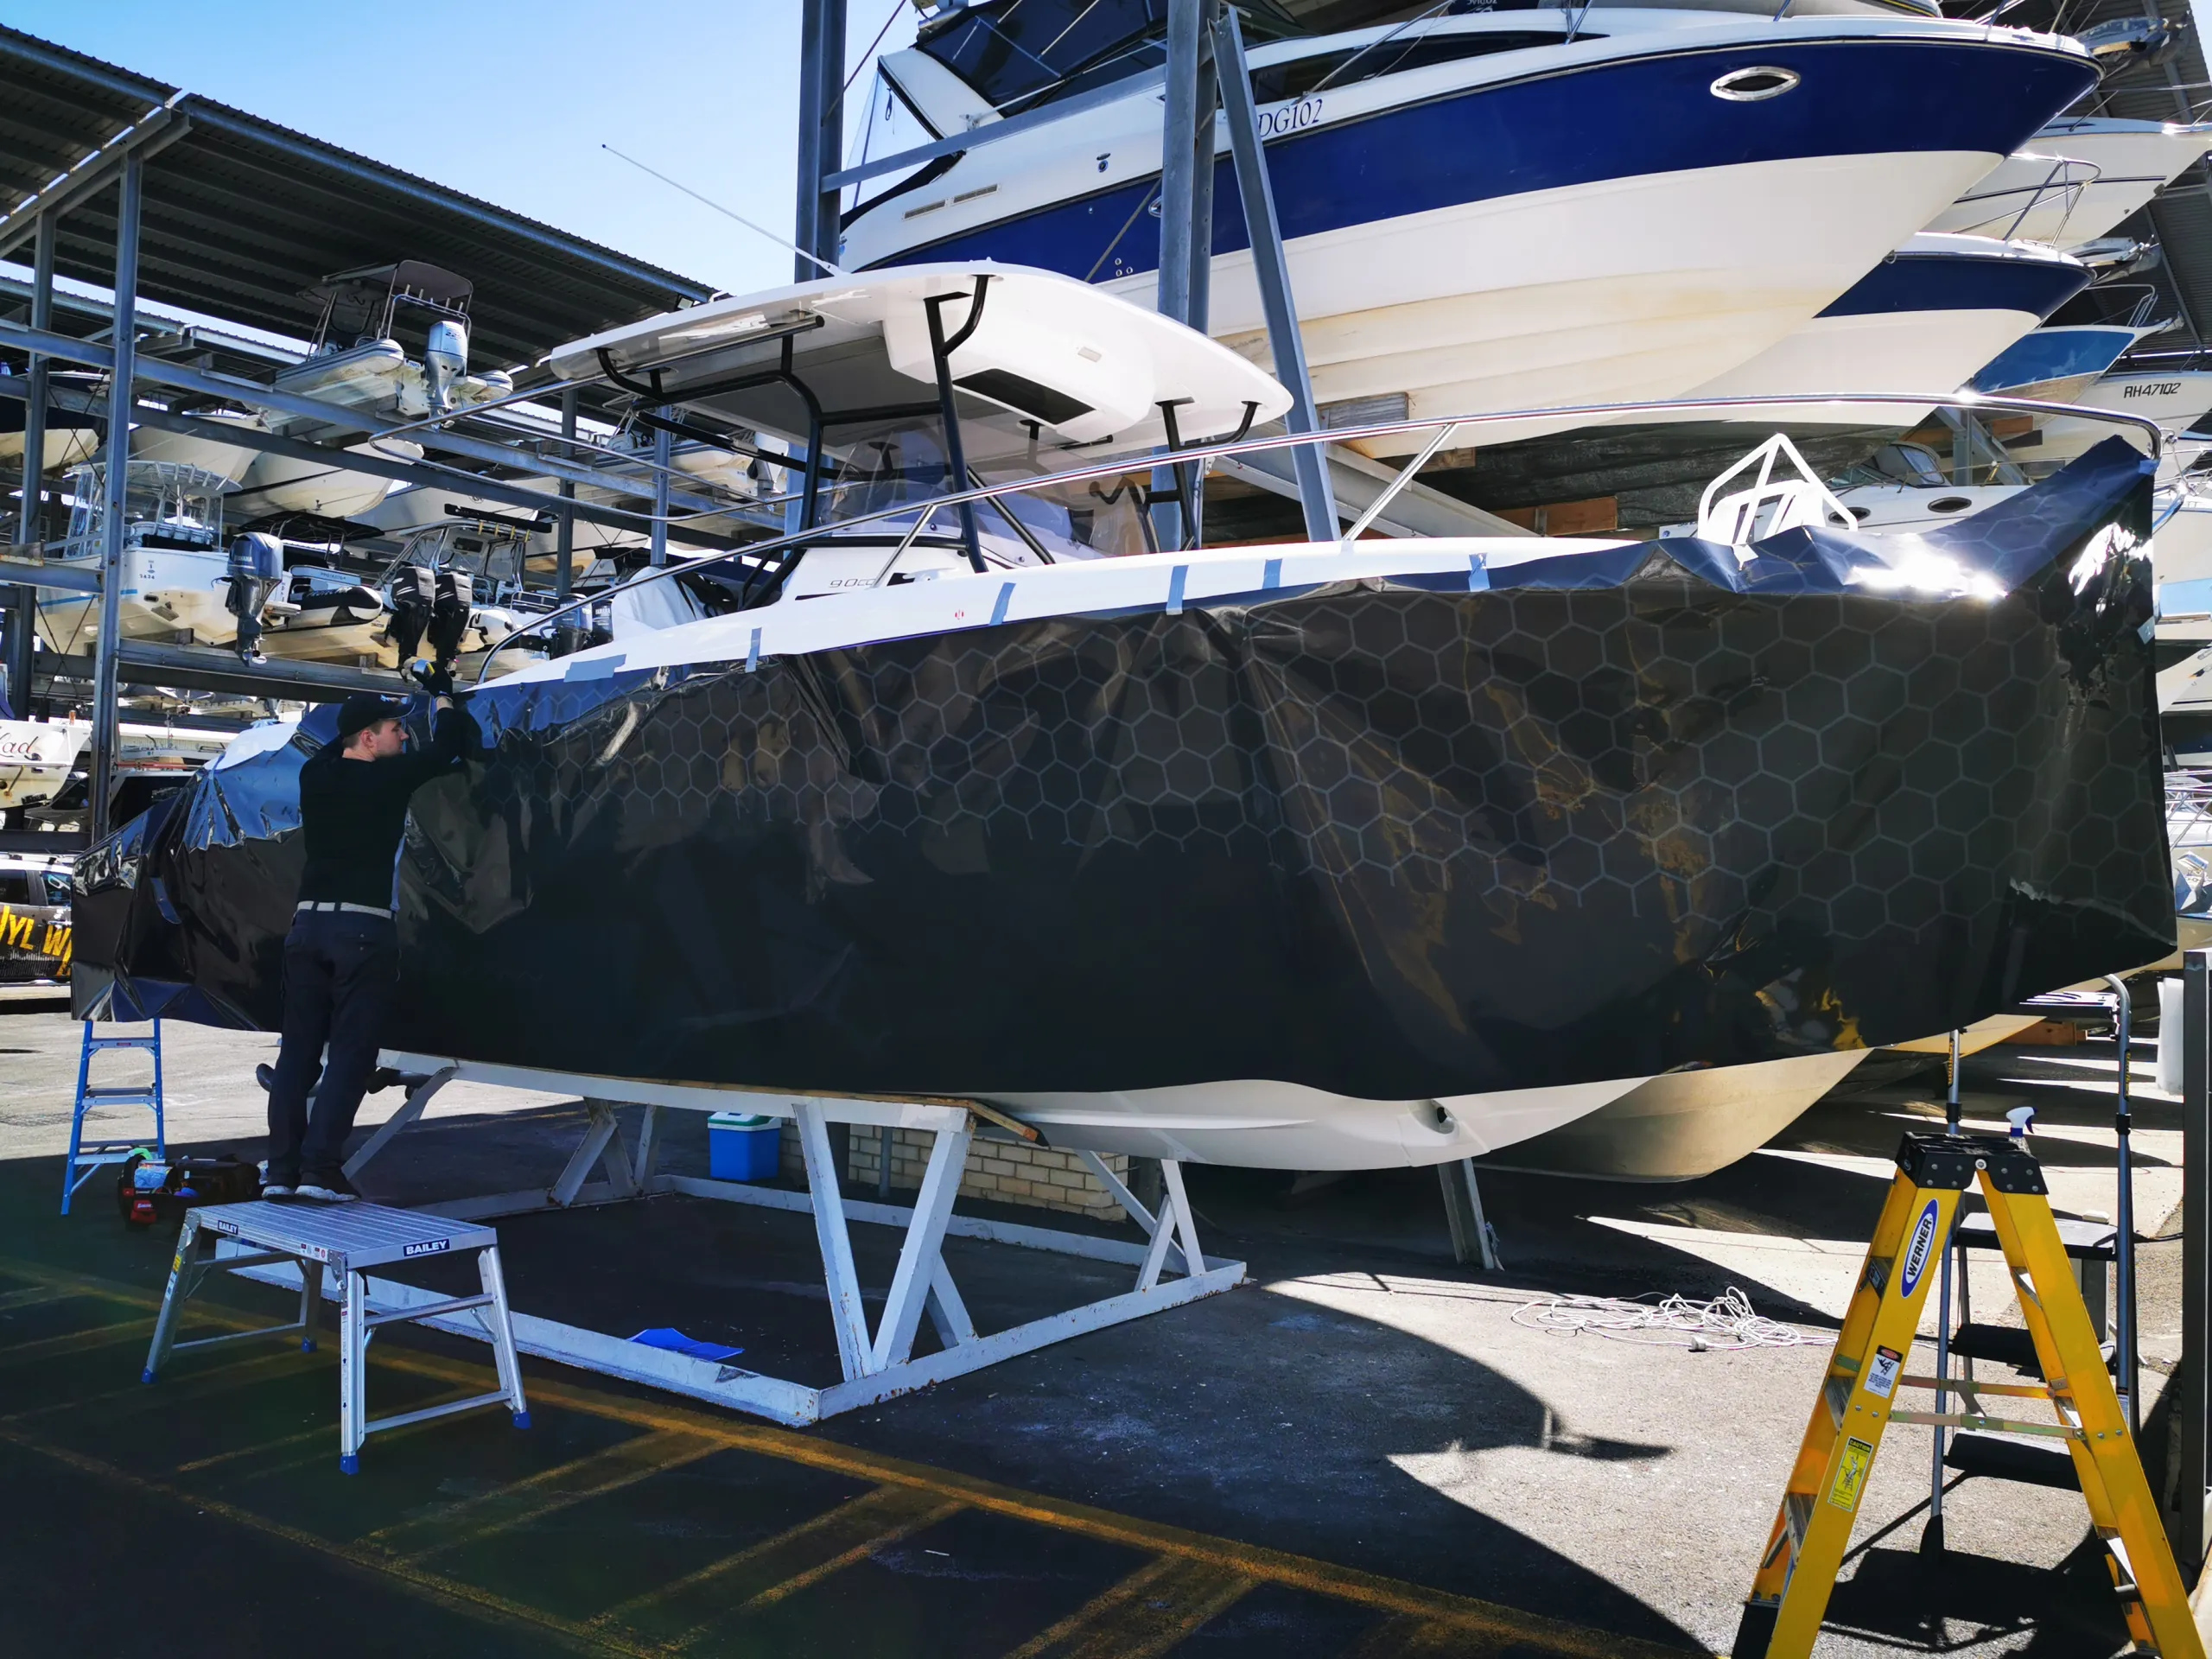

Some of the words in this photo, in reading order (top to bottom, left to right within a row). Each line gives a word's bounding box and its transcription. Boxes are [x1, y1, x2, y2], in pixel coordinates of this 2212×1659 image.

[1257, 98, 1323, 137] DG102
[218, 1220, 238, 1234] BAILEY
[405, 1240, 448, 1255] BAILEY
[1906, 1217, 1933, 1277] WERNER
